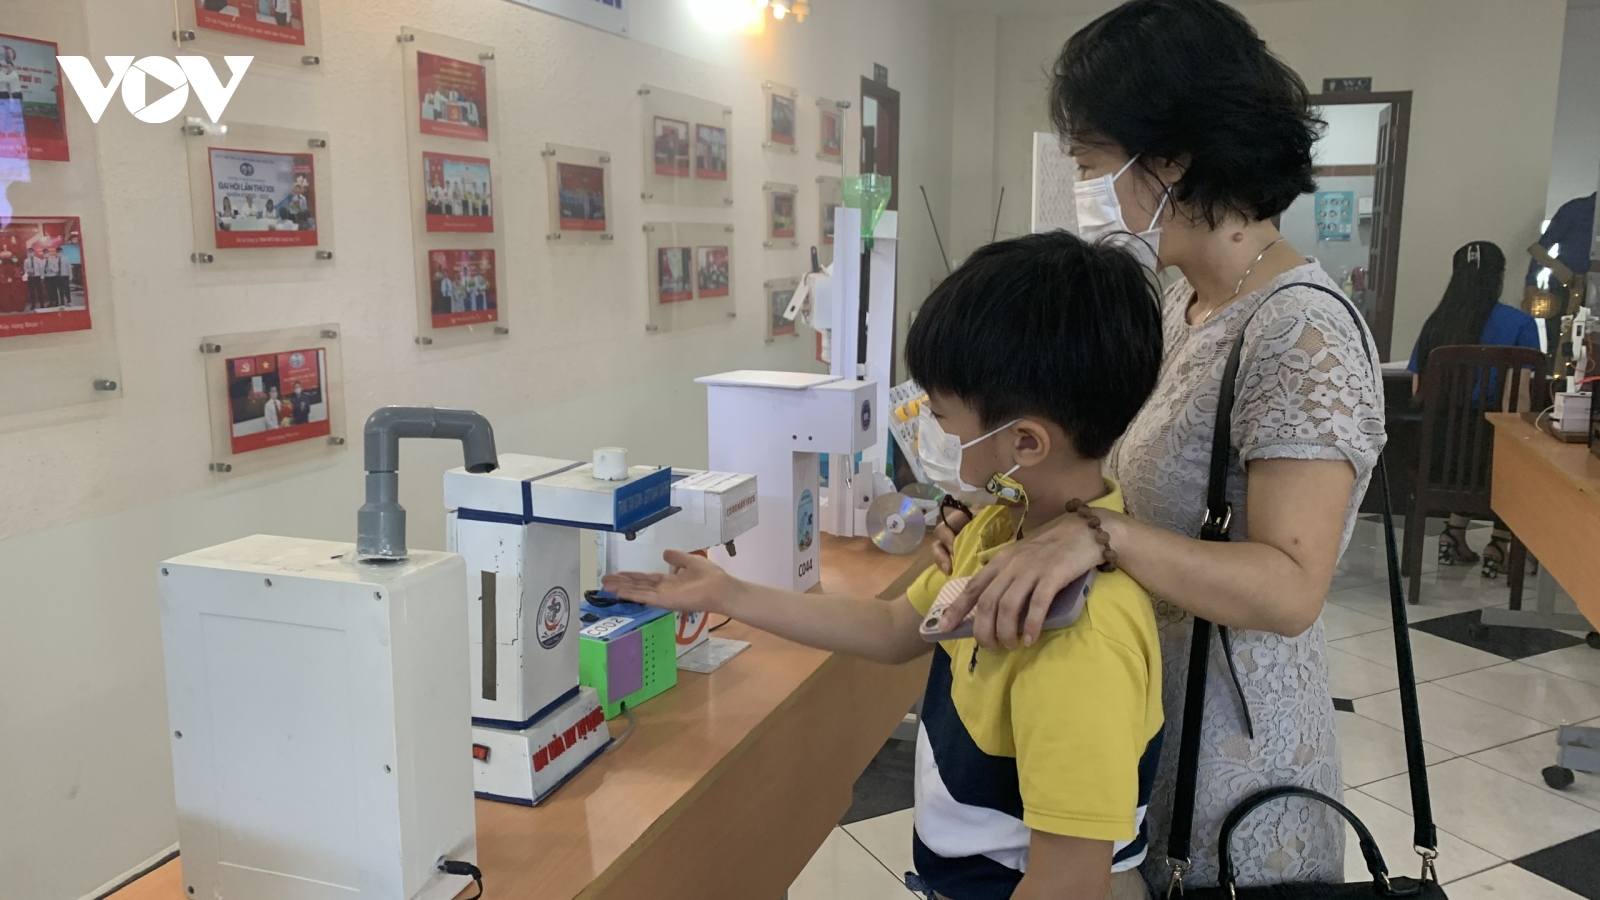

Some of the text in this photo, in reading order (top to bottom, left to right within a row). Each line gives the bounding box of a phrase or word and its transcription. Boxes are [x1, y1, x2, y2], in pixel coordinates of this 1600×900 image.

[726, 494, 756, 517] CORONAVIRUS
[798, 557, 812, 577] C044
[587, 618, 624, 635] C002
